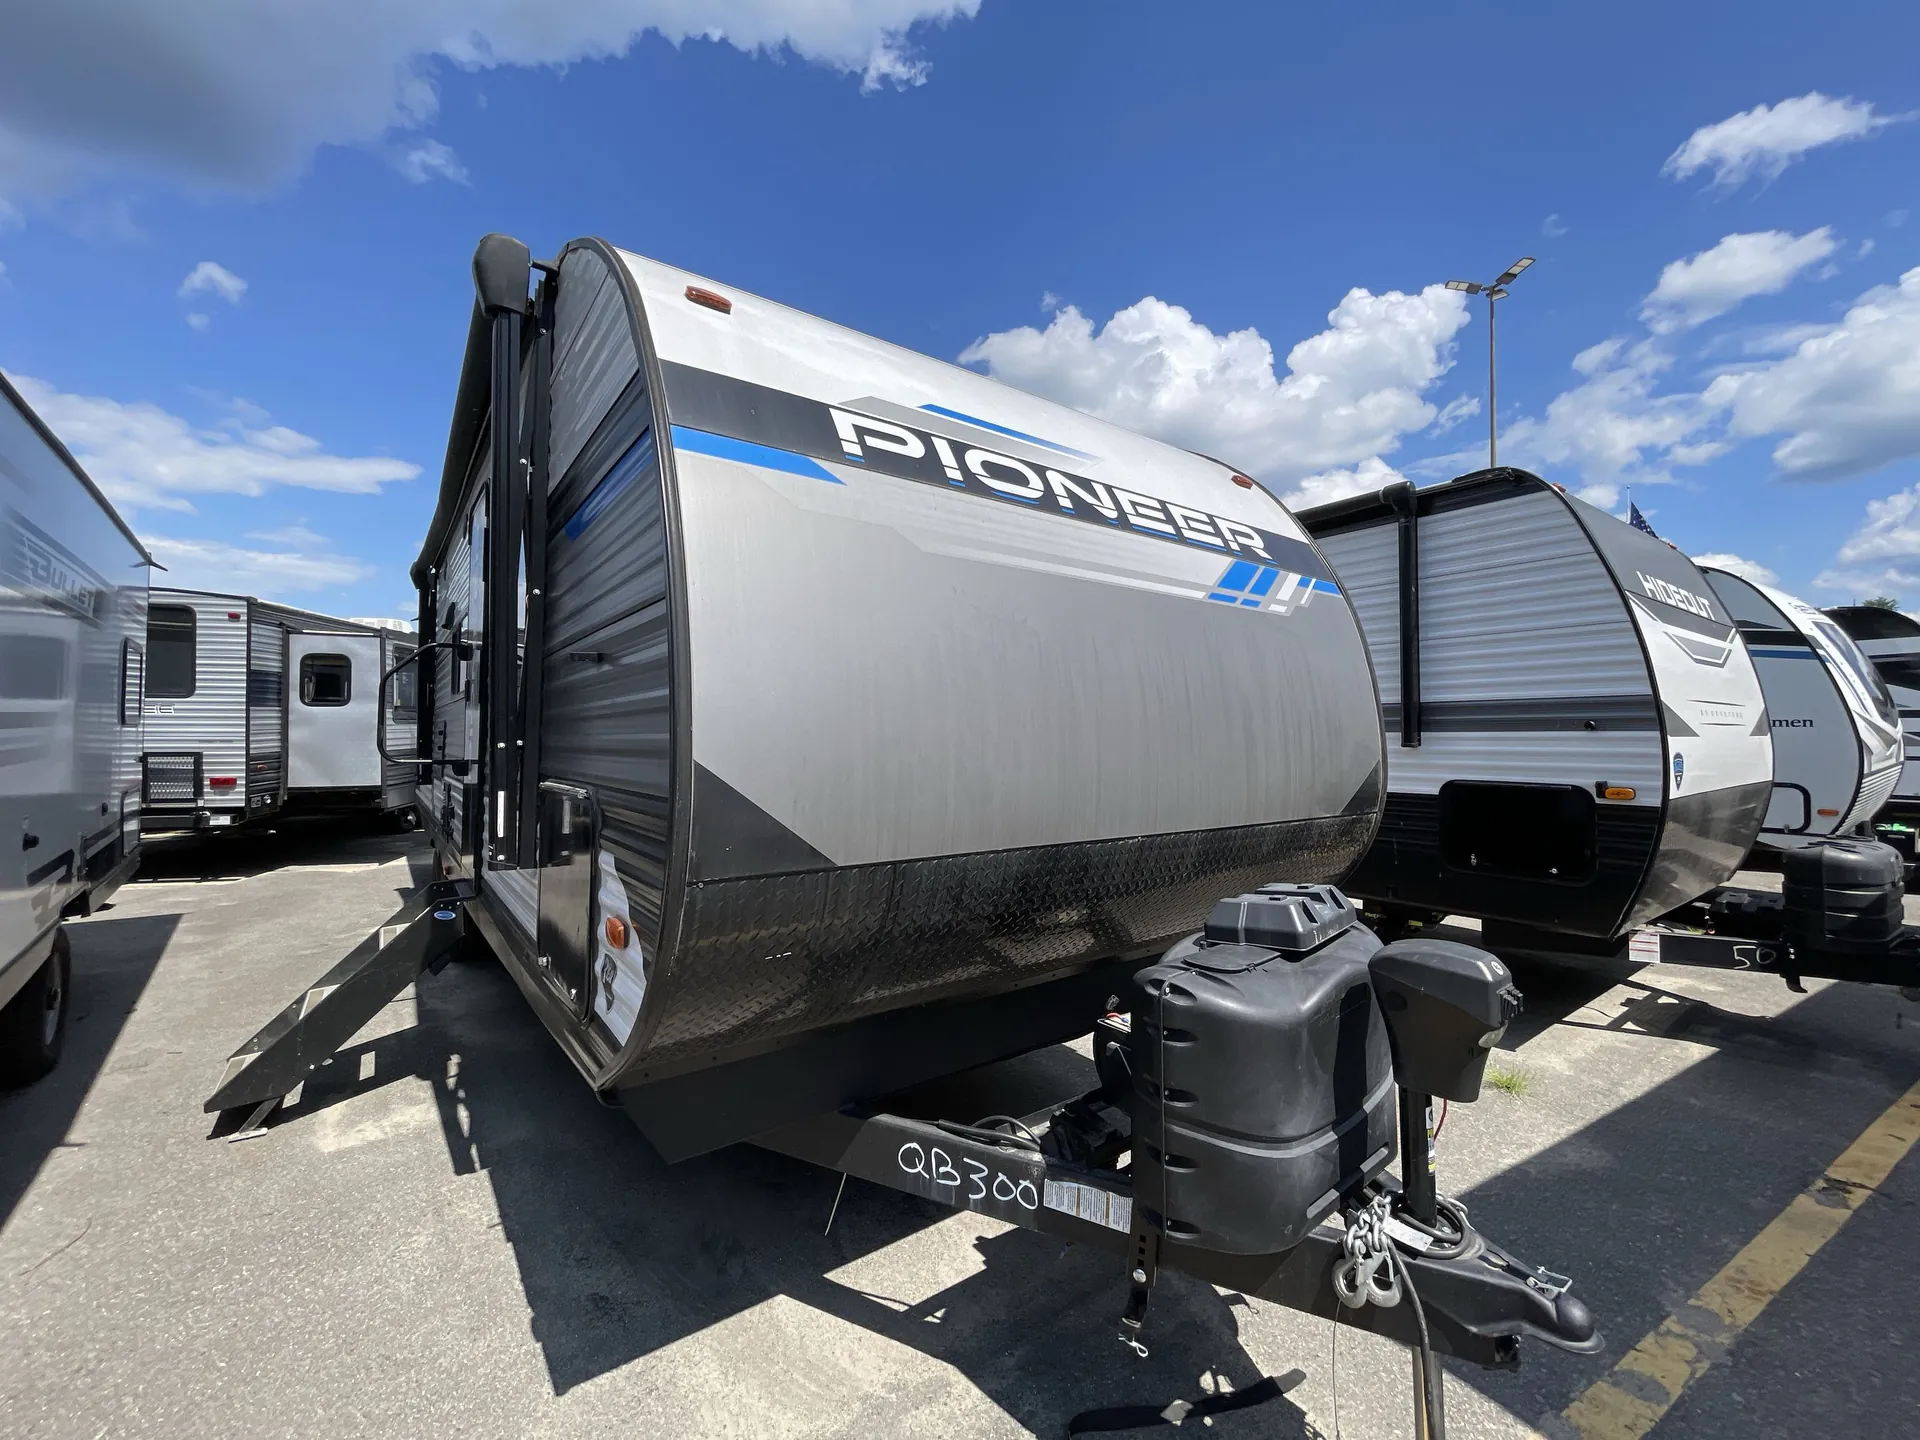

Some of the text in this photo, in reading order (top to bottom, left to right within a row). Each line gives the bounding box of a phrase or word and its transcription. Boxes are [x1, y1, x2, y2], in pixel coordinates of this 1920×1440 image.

[828, 407, 1276, 563] PIONEER
[1636, 571, 1715, 620] HIDEOUT
[898, 1142, 1038, 1210] QB300
